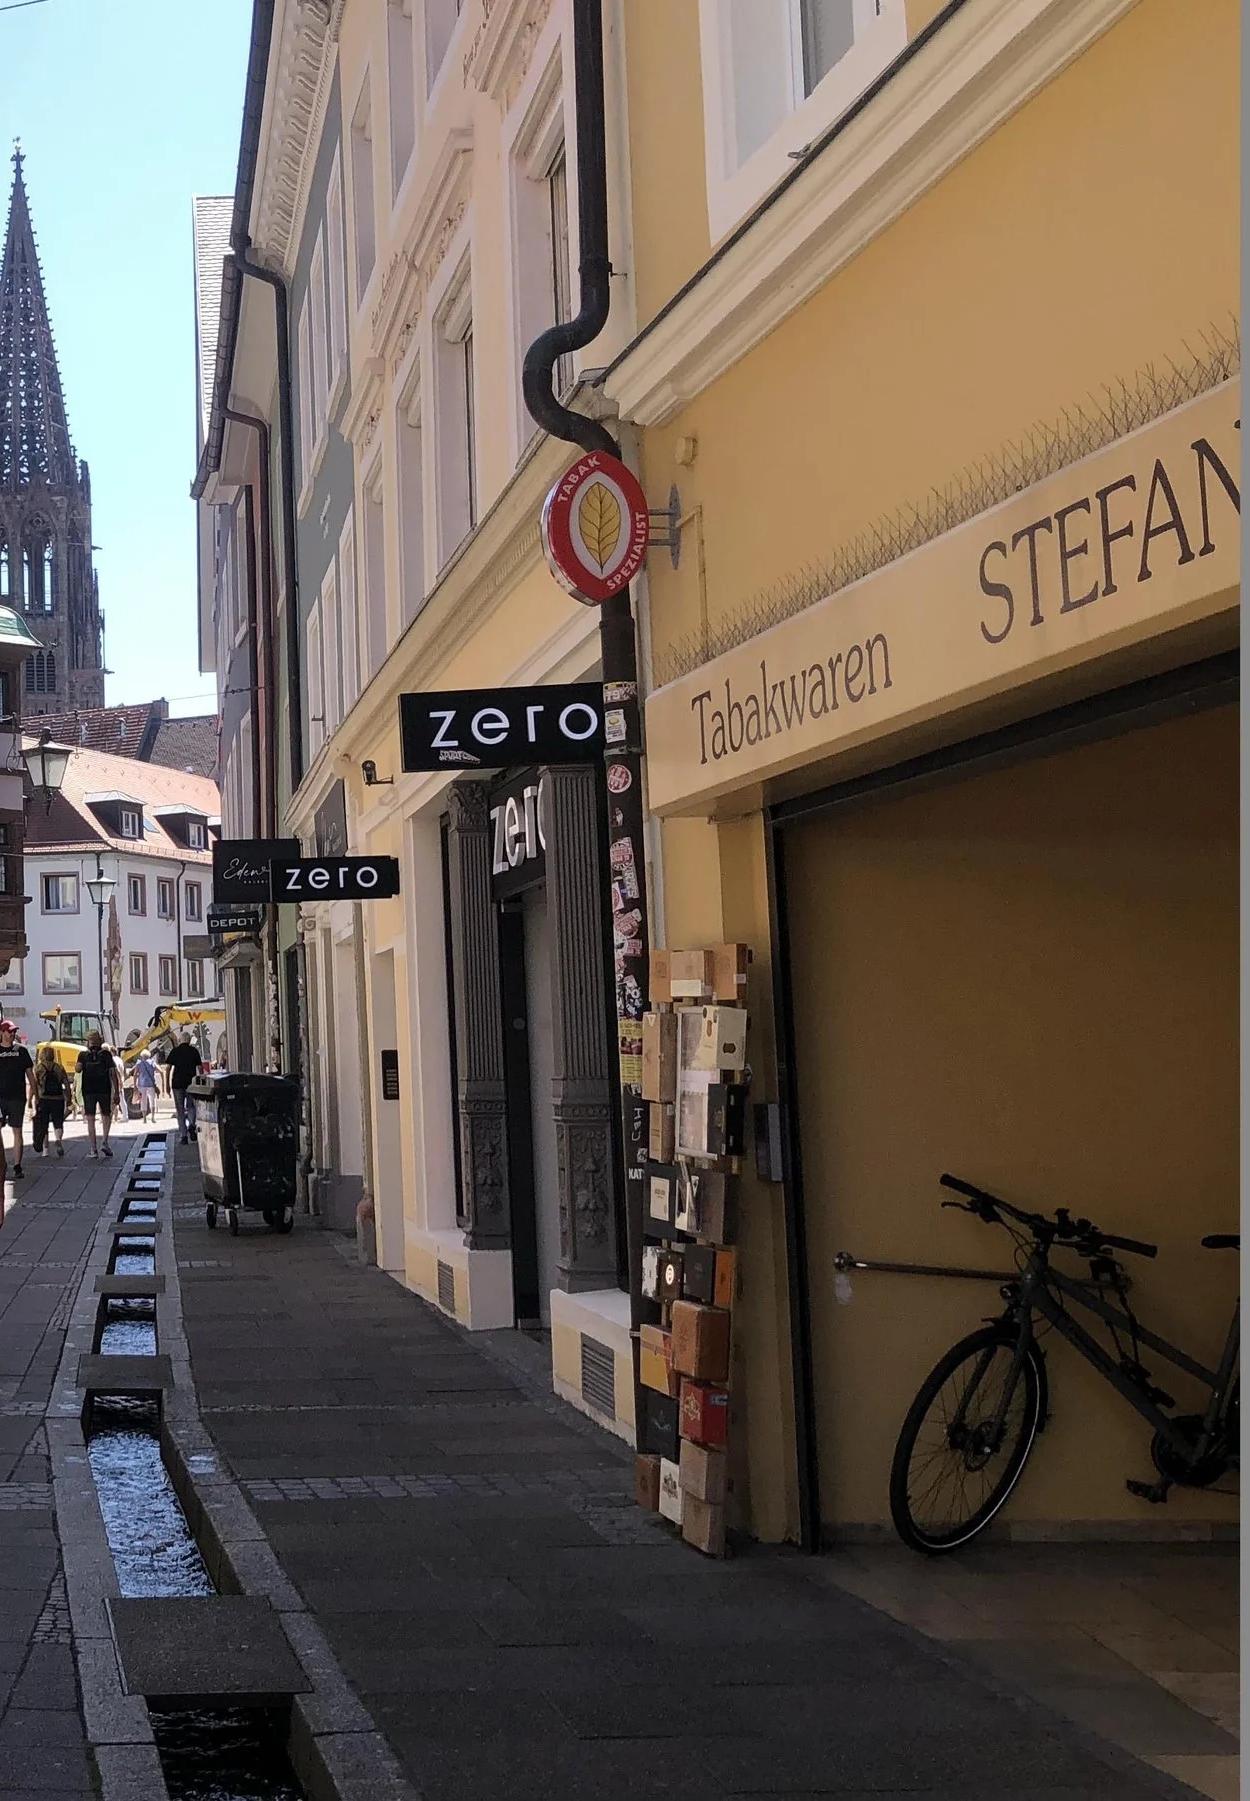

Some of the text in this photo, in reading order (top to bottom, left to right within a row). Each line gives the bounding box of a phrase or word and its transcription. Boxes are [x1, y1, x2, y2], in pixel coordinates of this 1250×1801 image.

[558, 455, 600, 502] TABAK
[606, 512, 646, 590] SPEZIALIST
[691, 633, 892, 764] Tabakwaren
[429, 703, 598, 748] zero
[286, 866, 378, 890] zero
[210, 917, 256, 928] DEPOT
